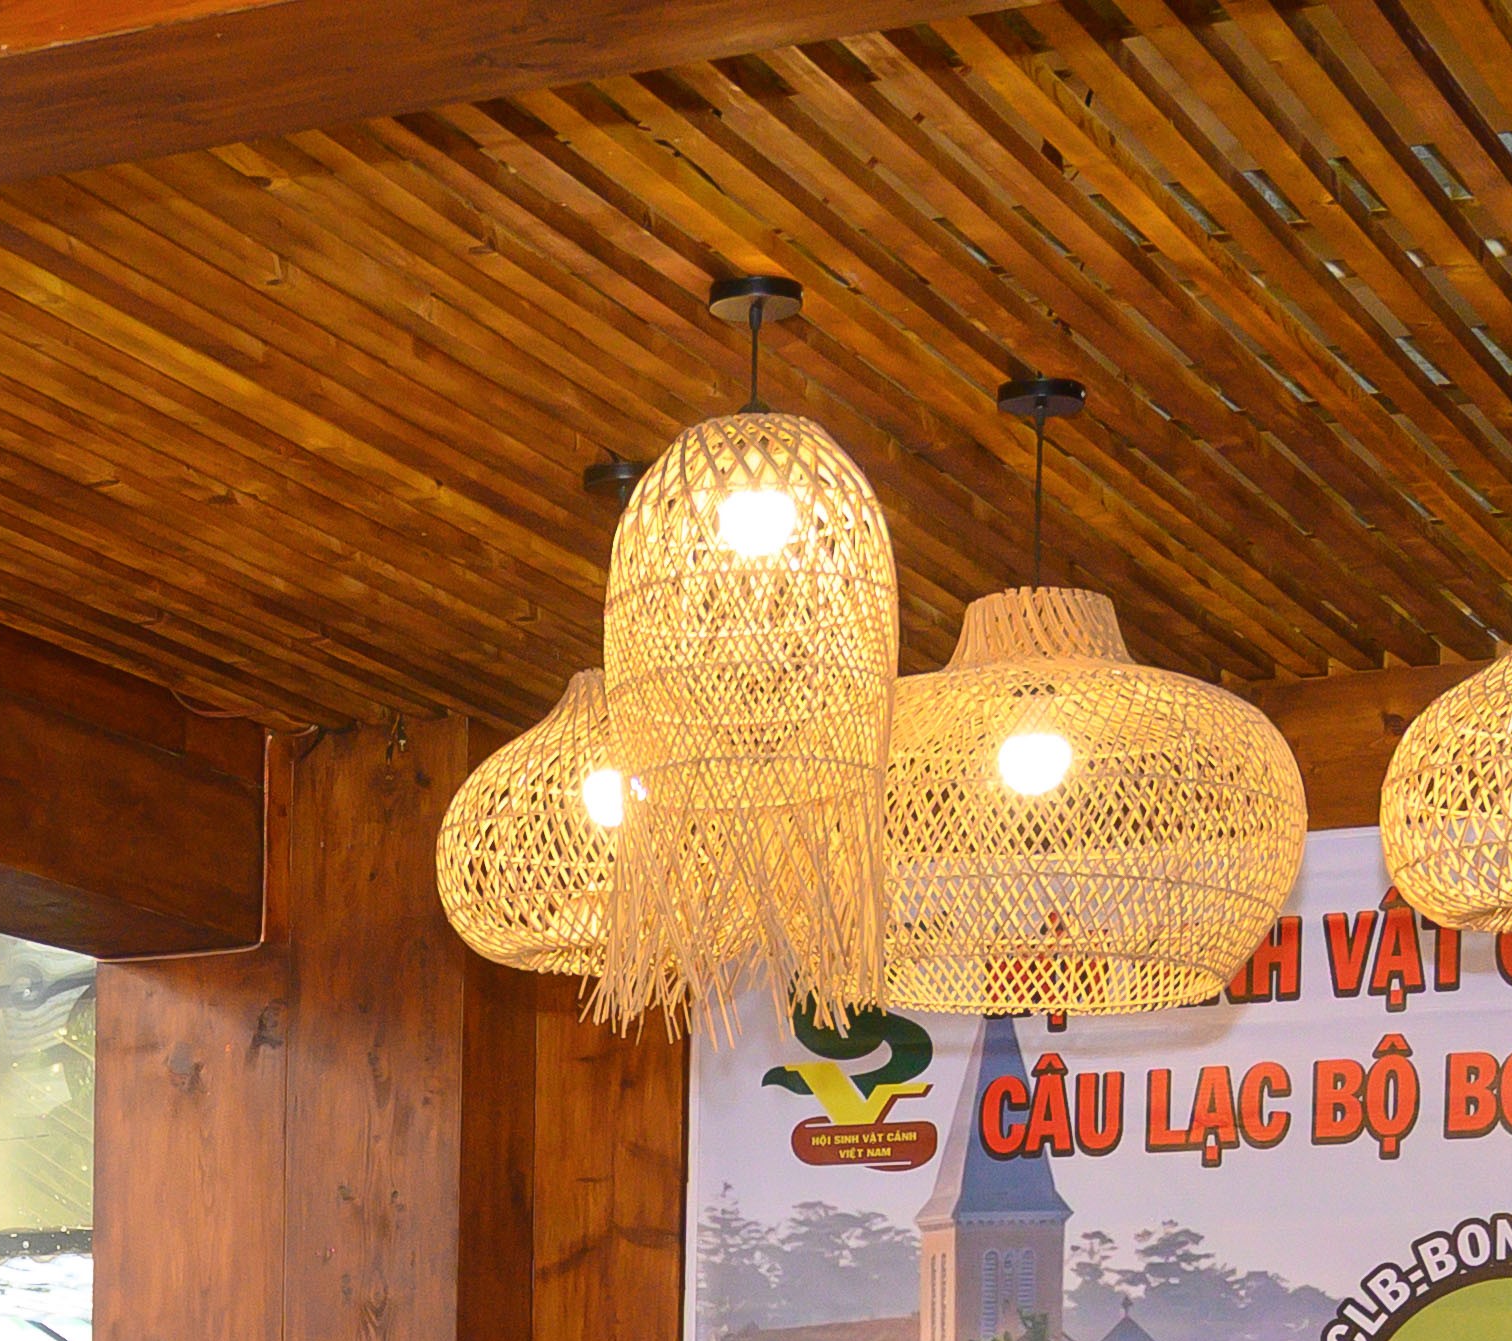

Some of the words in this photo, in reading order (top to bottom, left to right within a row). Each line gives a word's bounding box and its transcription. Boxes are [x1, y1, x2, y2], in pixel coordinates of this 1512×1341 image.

[1323, 885, 1463, 1012] VẬT
[979, 1052, 1125, 1162] CÂU
[1144, 1062, 1294, 1168] LẠC
[1310, 1033, 1420, 1161] BỘ
[811, 1133, 831, 1147] HỘI
[834, 1134, 859, 1145] SINH
[866, 1147, 892, 1158] NAM
